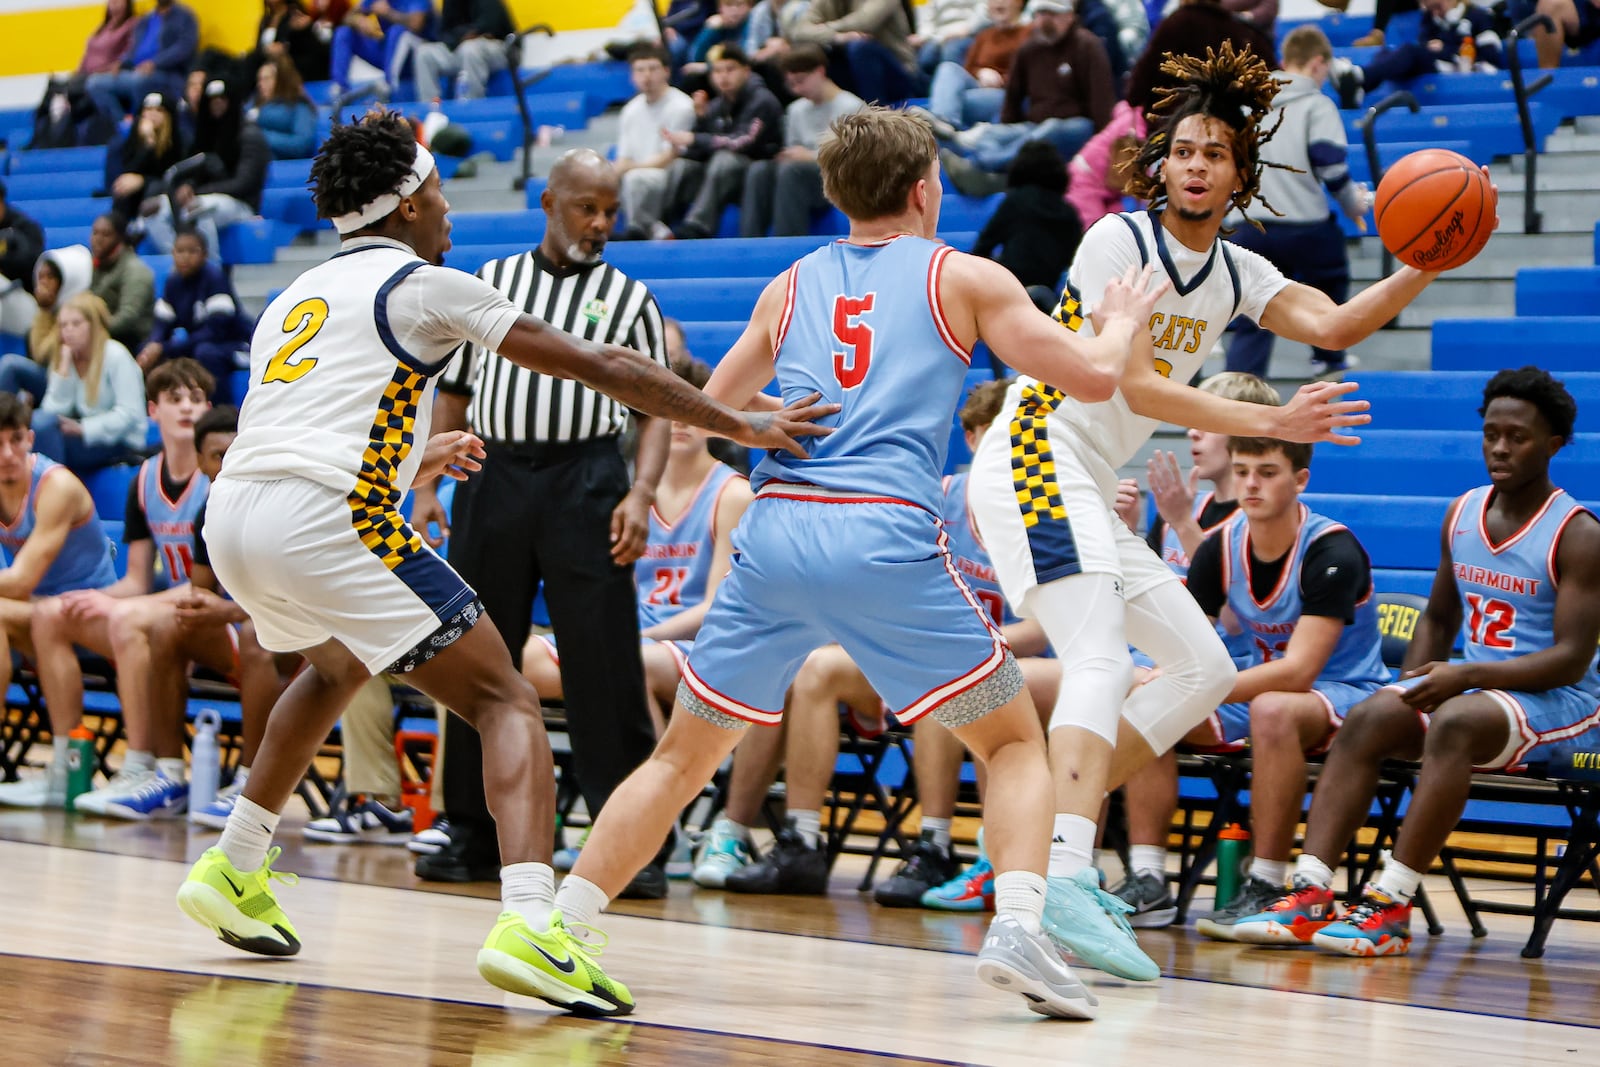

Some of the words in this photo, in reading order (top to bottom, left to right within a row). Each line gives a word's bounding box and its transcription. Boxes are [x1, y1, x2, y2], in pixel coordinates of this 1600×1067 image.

[1413, 209, 1465, 266] Rawlings
[261, 297, 330, 385] 2
[831, 291, 877, 392] 5
[1452, 562, 1541, 597] FAIRMONT
[1465, 592, 1517, 651] 12
